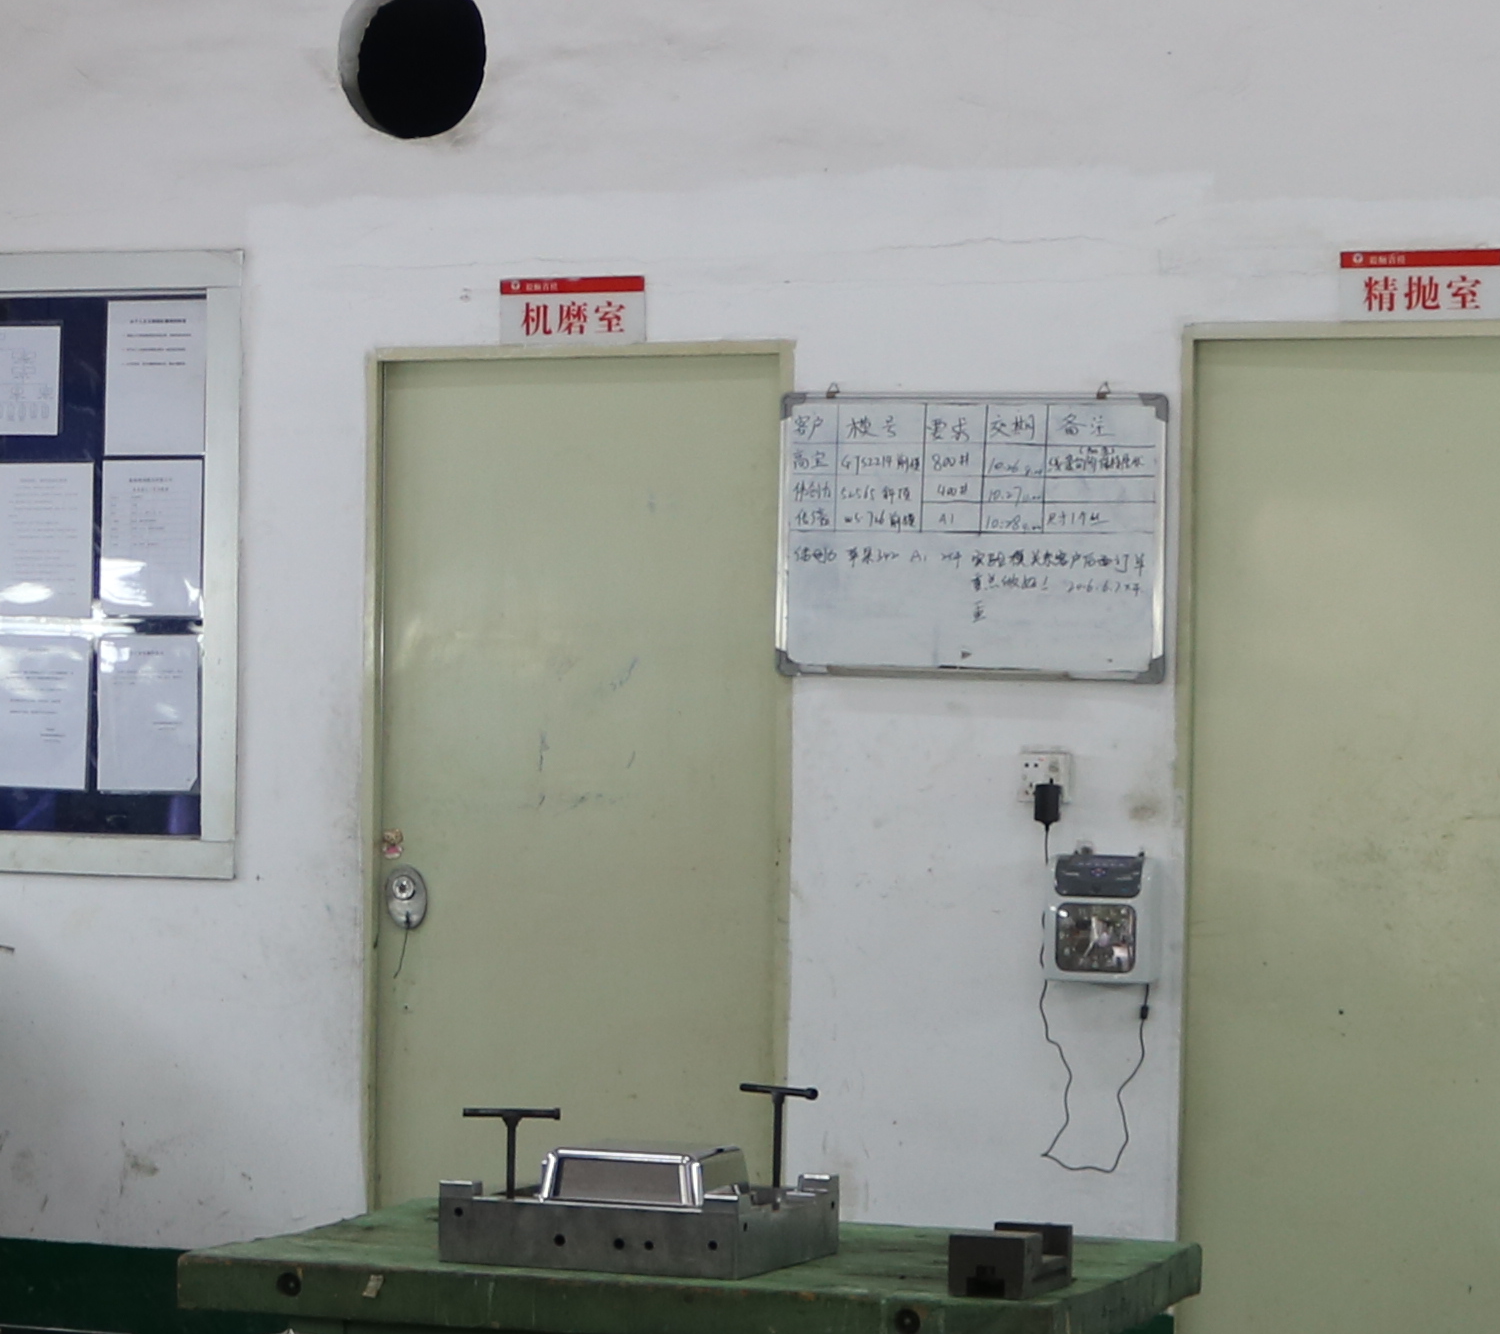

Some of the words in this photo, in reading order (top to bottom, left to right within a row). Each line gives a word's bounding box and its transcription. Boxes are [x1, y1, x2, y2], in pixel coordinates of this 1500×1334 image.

[1363, 274, 1483, 313] 精抛室
[520, 299, 628, 338] 机磨室
[793, 415, 825, 441] 客户
[925, 416, 971, 442] 要求
[988, 414, 1037, 441] 交期
[1056, 412, 1116, 438] 备注
